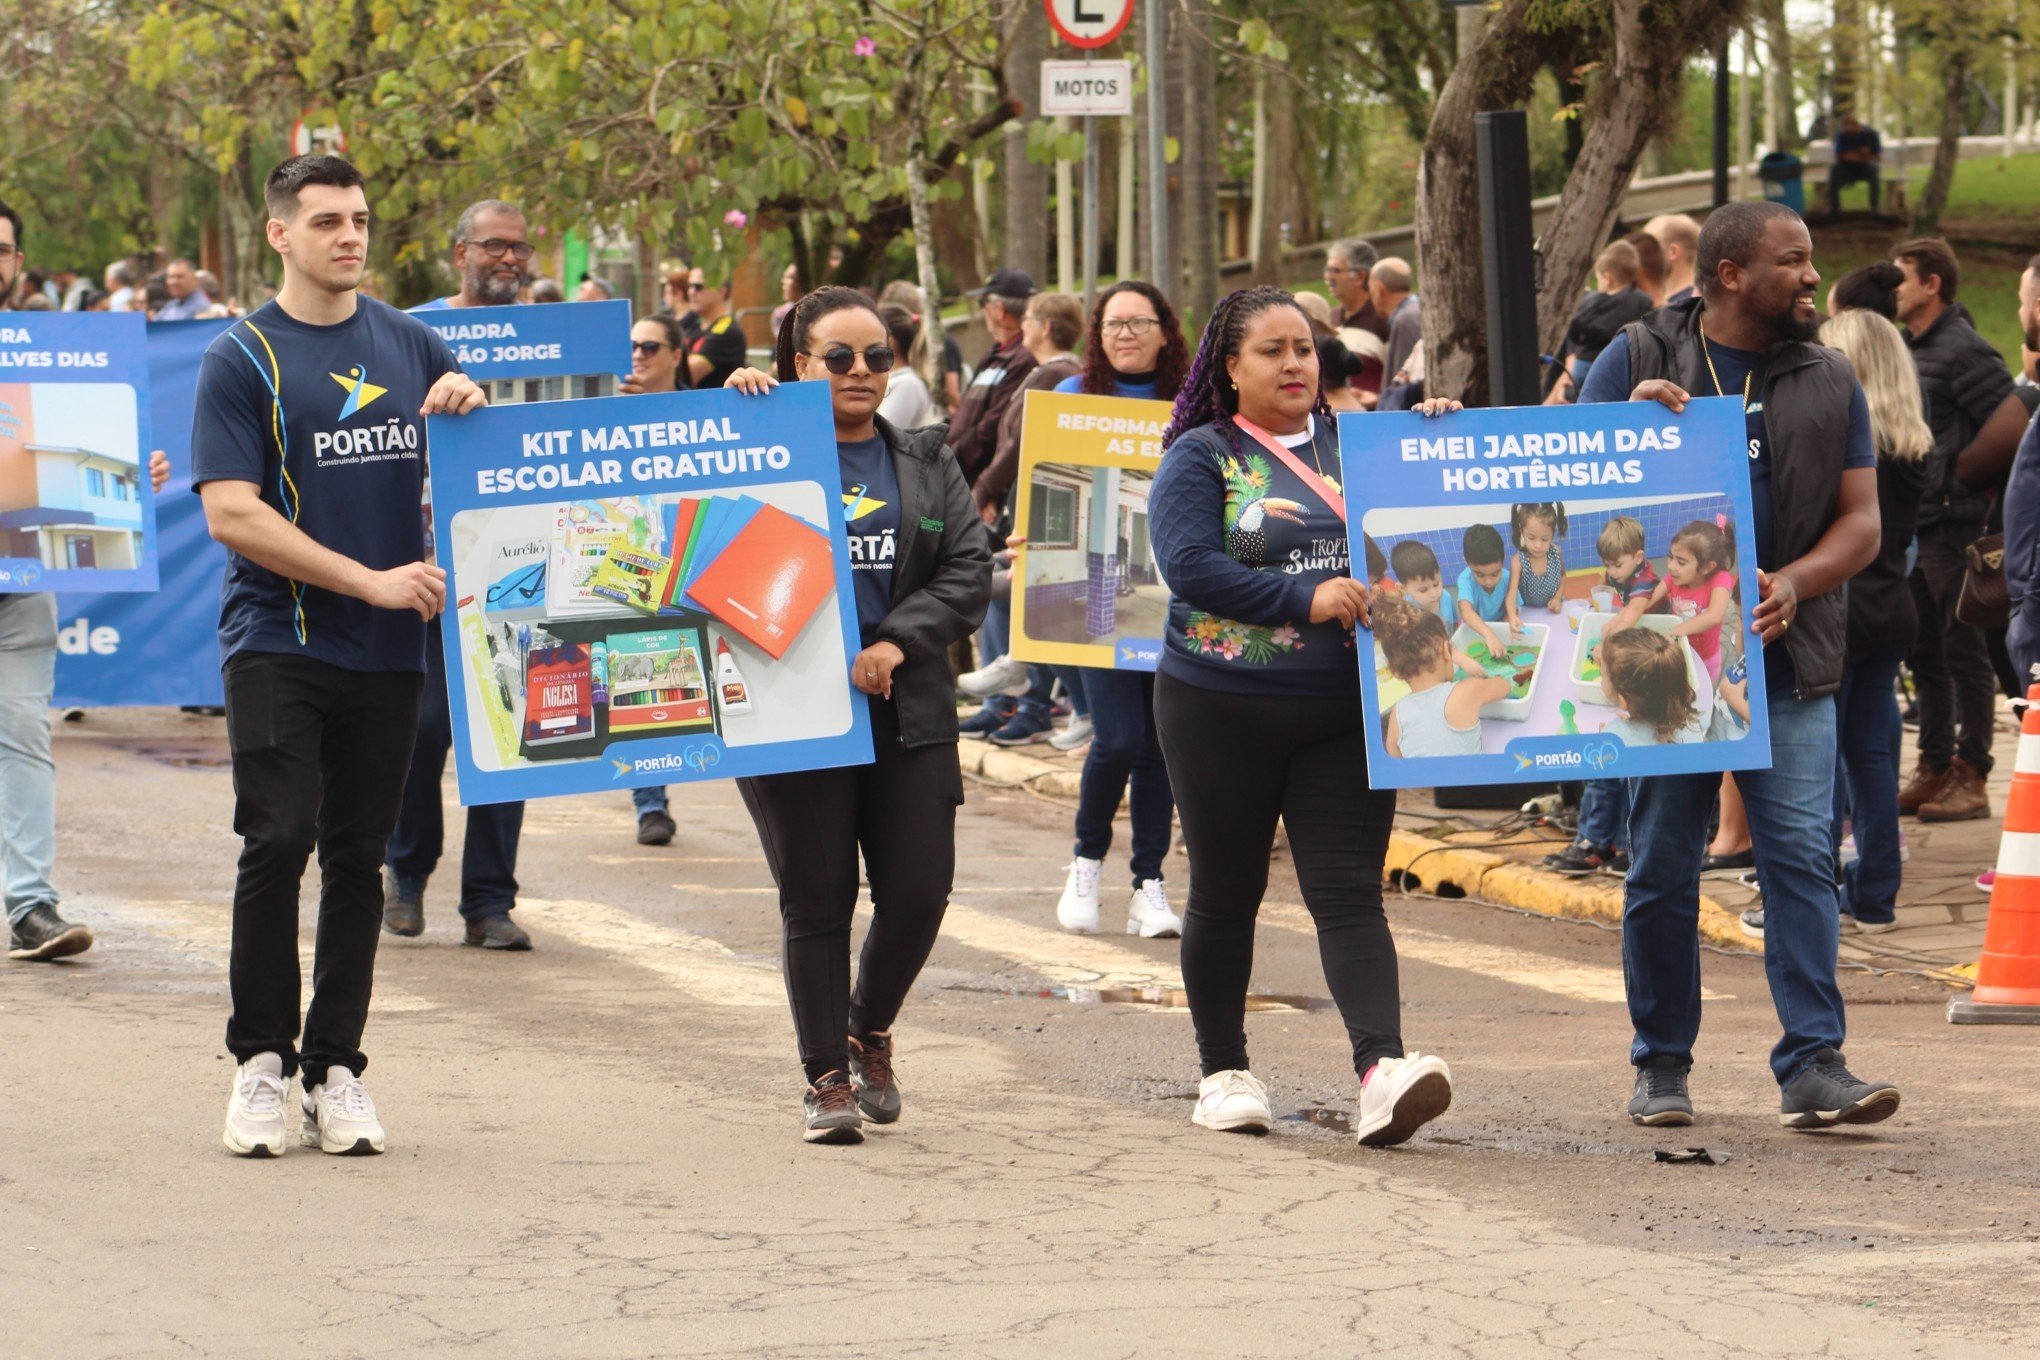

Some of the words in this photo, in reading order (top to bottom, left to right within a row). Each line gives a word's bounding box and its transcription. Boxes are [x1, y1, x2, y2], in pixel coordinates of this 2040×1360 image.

[1055, 80, 1118, 96] MOTOS
[0, 328, 32, 344] RA
[0, 351, 53, 367] LVES
[57, 351, 109, 368] DIAS
[450, 344, 488, 364] ÃO
[492, 344, 562, 362] JORGE
[314, 417, 418, 458] PORTÃO
[522, 430, 573, 457] KIT
[581, 417, 741, 453] MATERIAL
[1105, 438, 1136, 455] AS
[1401, 436, 1476, 462] EMEI
[1484, 430, 1606, 459] JARDIM
[1614, 426, 1682, 452] DAS
[317, 456, 360, 467] Construindo
[382, 452, 400, 461] nossa
[477, 460, 623, 495] ESCOLAR
[631, 445, 791, 481] GRATUITO
[1442, 458, 1644, 492] HORTÊNSIAS
[847, 528, 898, 560] RTÃ
[542, 684, 578, 708] INGLESA
[634, 753, 683, 772] PORTÃO
[1535, 749, 1582, 766] PORTÃO
